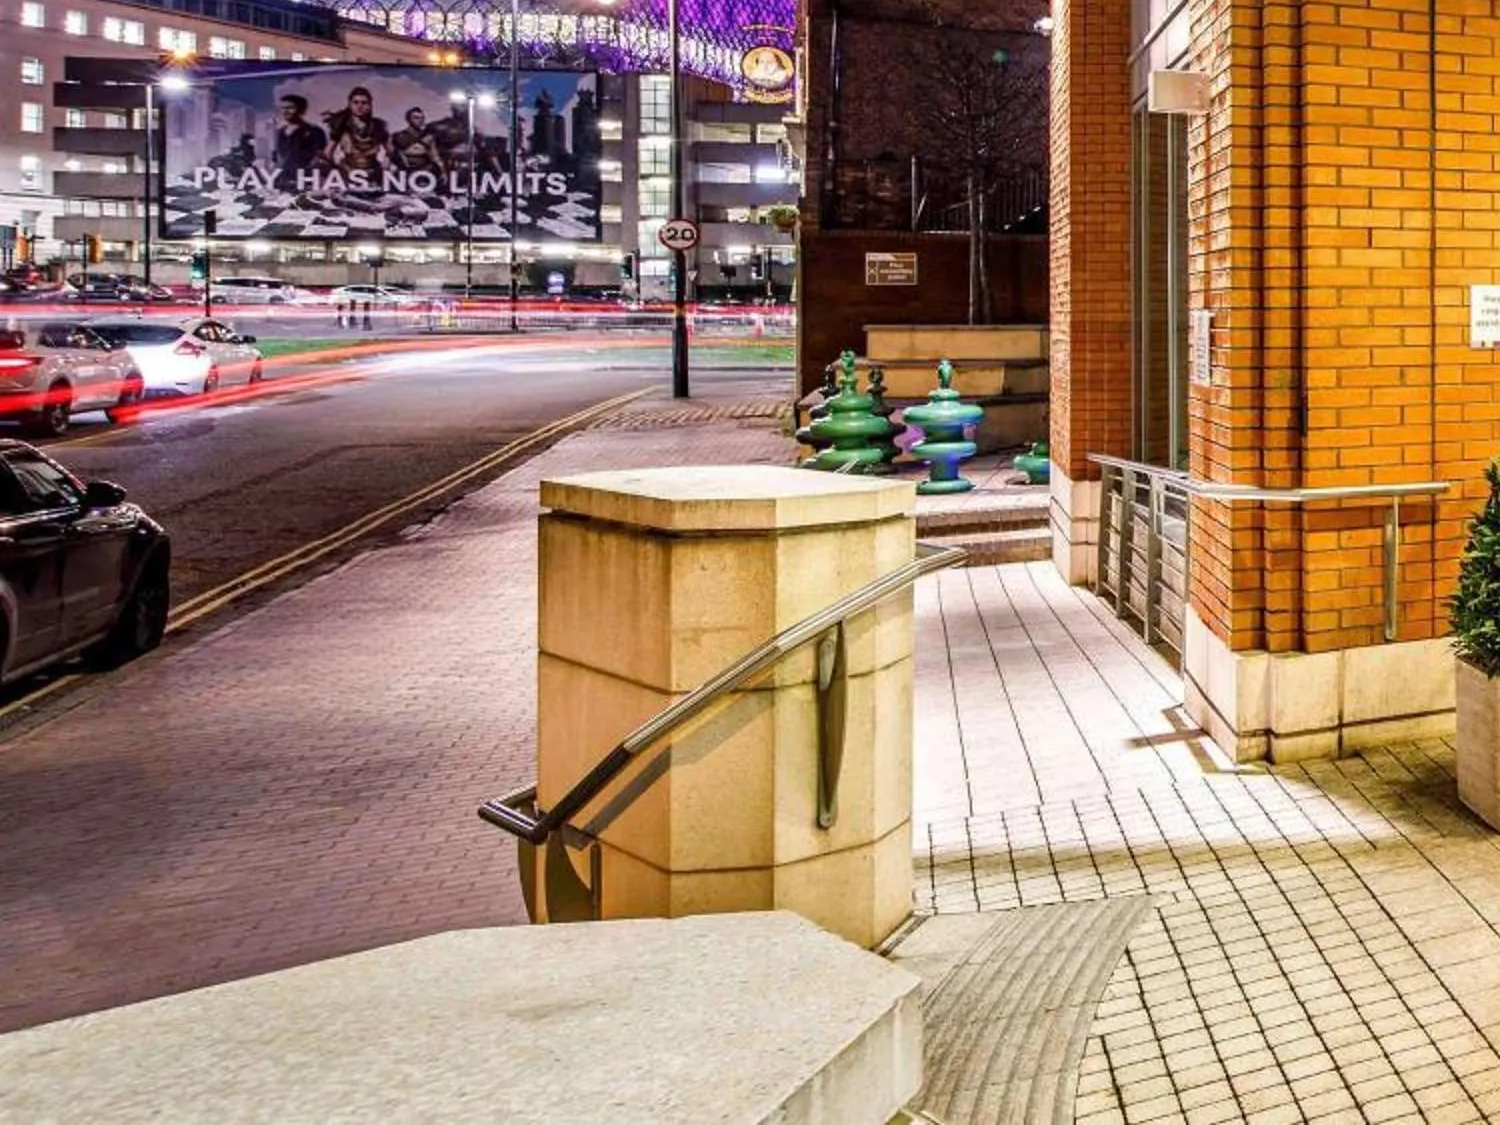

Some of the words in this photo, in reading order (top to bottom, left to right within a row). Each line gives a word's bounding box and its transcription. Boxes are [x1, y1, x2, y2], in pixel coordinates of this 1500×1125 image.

[193, 166, 283, 191] PLAY
[297, 168, 368, 192] HAS
[383, 170, 437, 192] NO
[666, 227, 694, 242] 20
